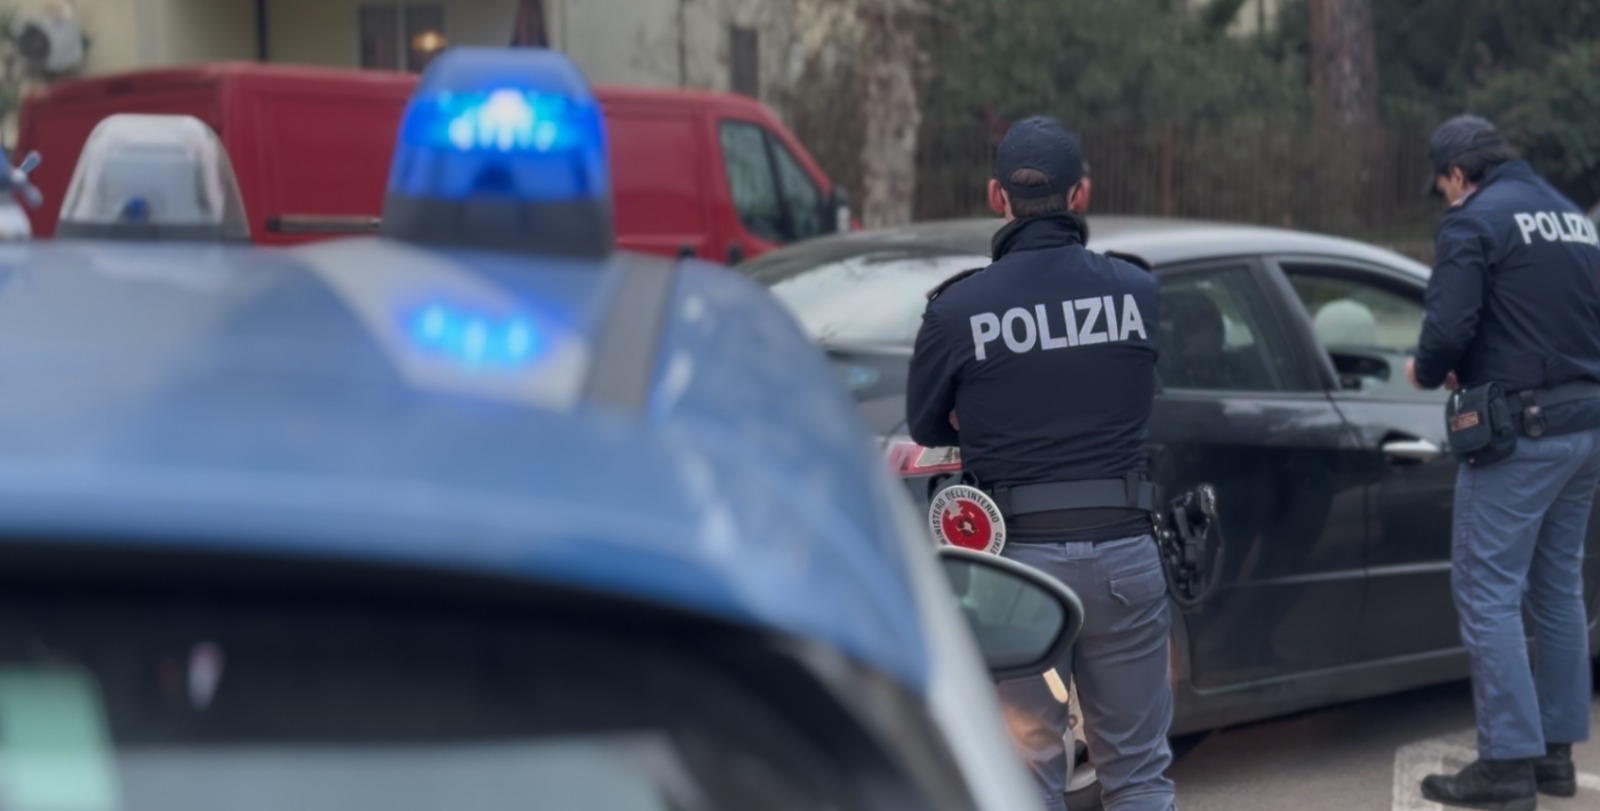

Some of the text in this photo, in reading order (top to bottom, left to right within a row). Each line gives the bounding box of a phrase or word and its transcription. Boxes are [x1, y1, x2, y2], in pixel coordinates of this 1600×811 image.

[1513, 210, 1600, 249] POLIZI
[970, 294, 1147, 361] POLIZIA
[944, 488, 999, 523] DELL'INTERNO
